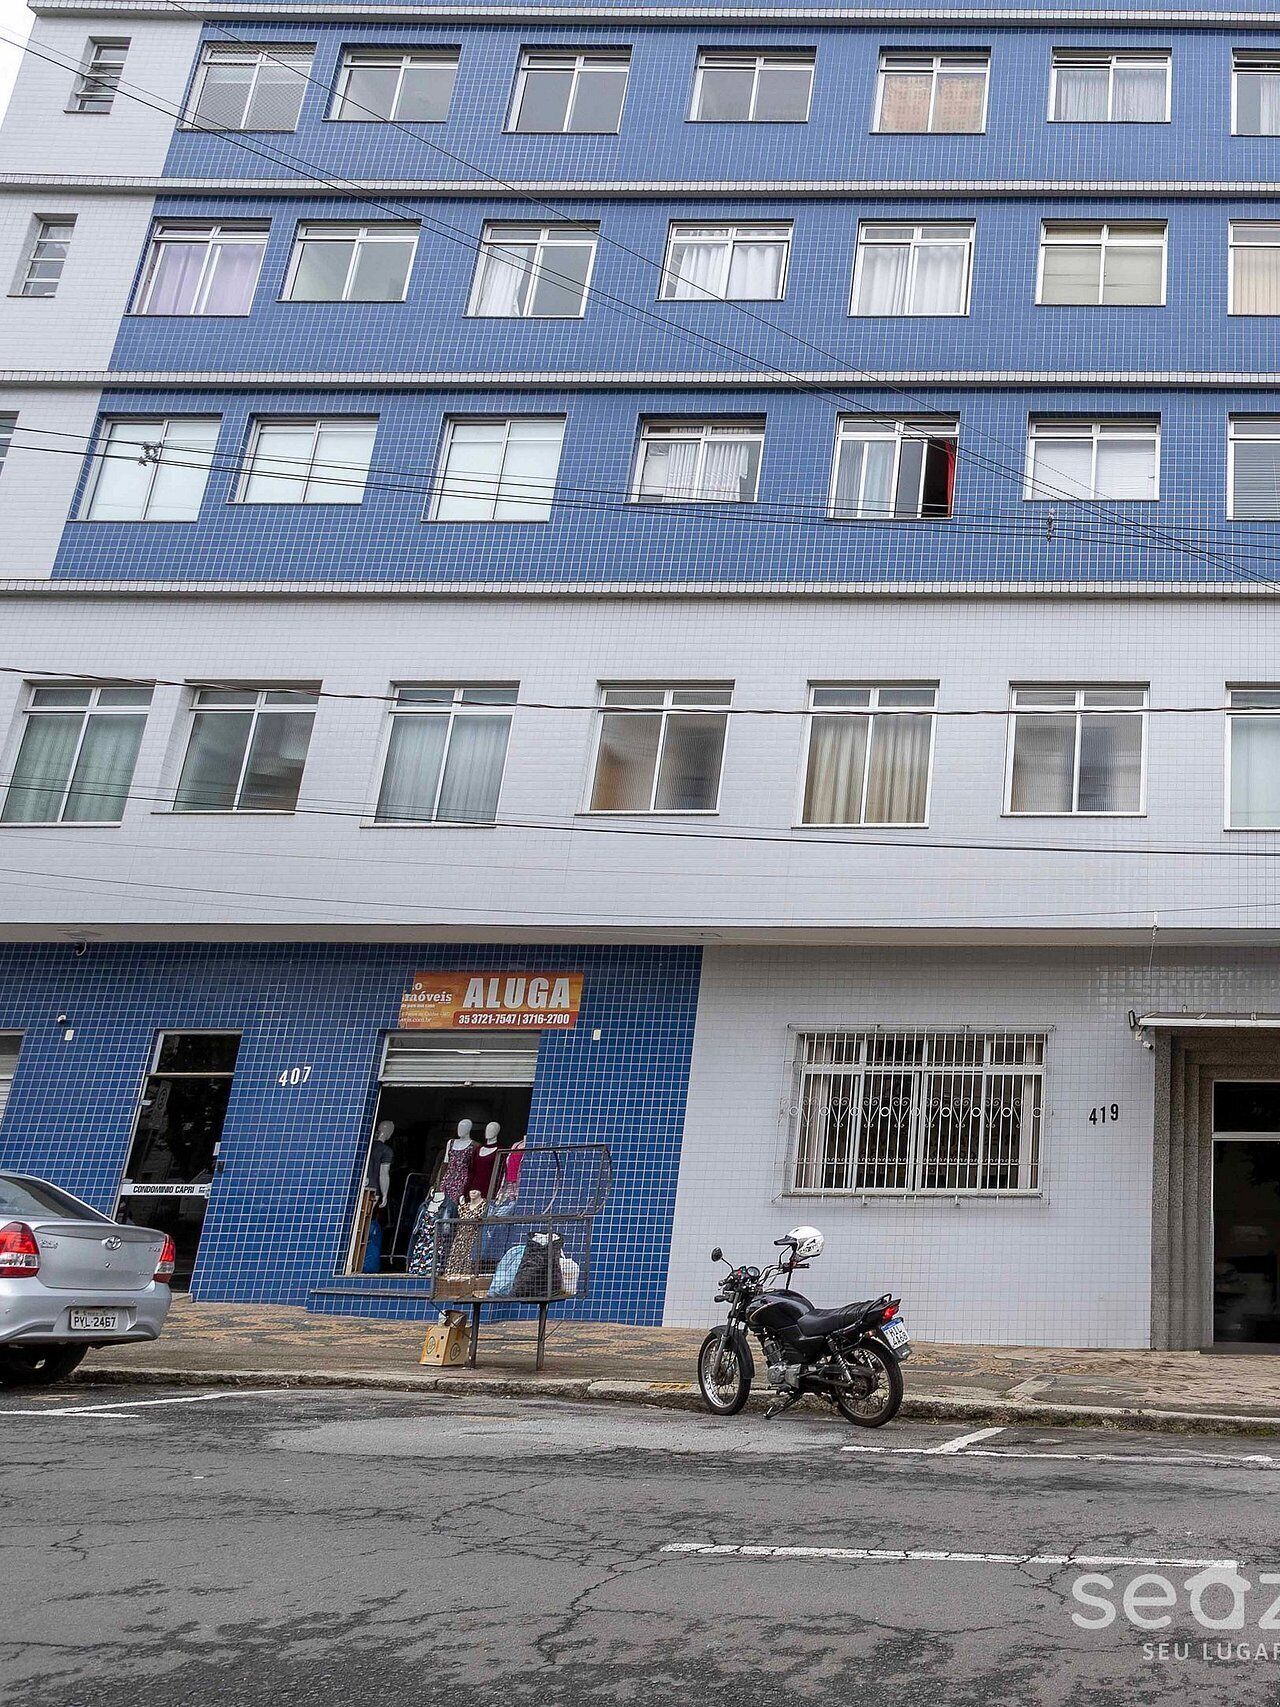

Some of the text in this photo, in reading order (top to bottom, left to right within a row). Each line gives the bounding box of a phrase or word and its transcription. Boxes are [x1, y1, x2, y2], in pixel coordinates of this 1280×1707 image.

[462, 977, 570, 1009] ALUGA
[458, 1014, 470, 1024] 35
[471, 1013, 517, 1024] 3721-7547
[522, 1013, 570, 1024] 3716-2700
[278, 1066, 312, 1087] 407
[1088, 1103, 1119, 1126] 419
[174, 1185, 195, 1194] CAPRI
[73, 1316, 117, 1329] PYL-2467
